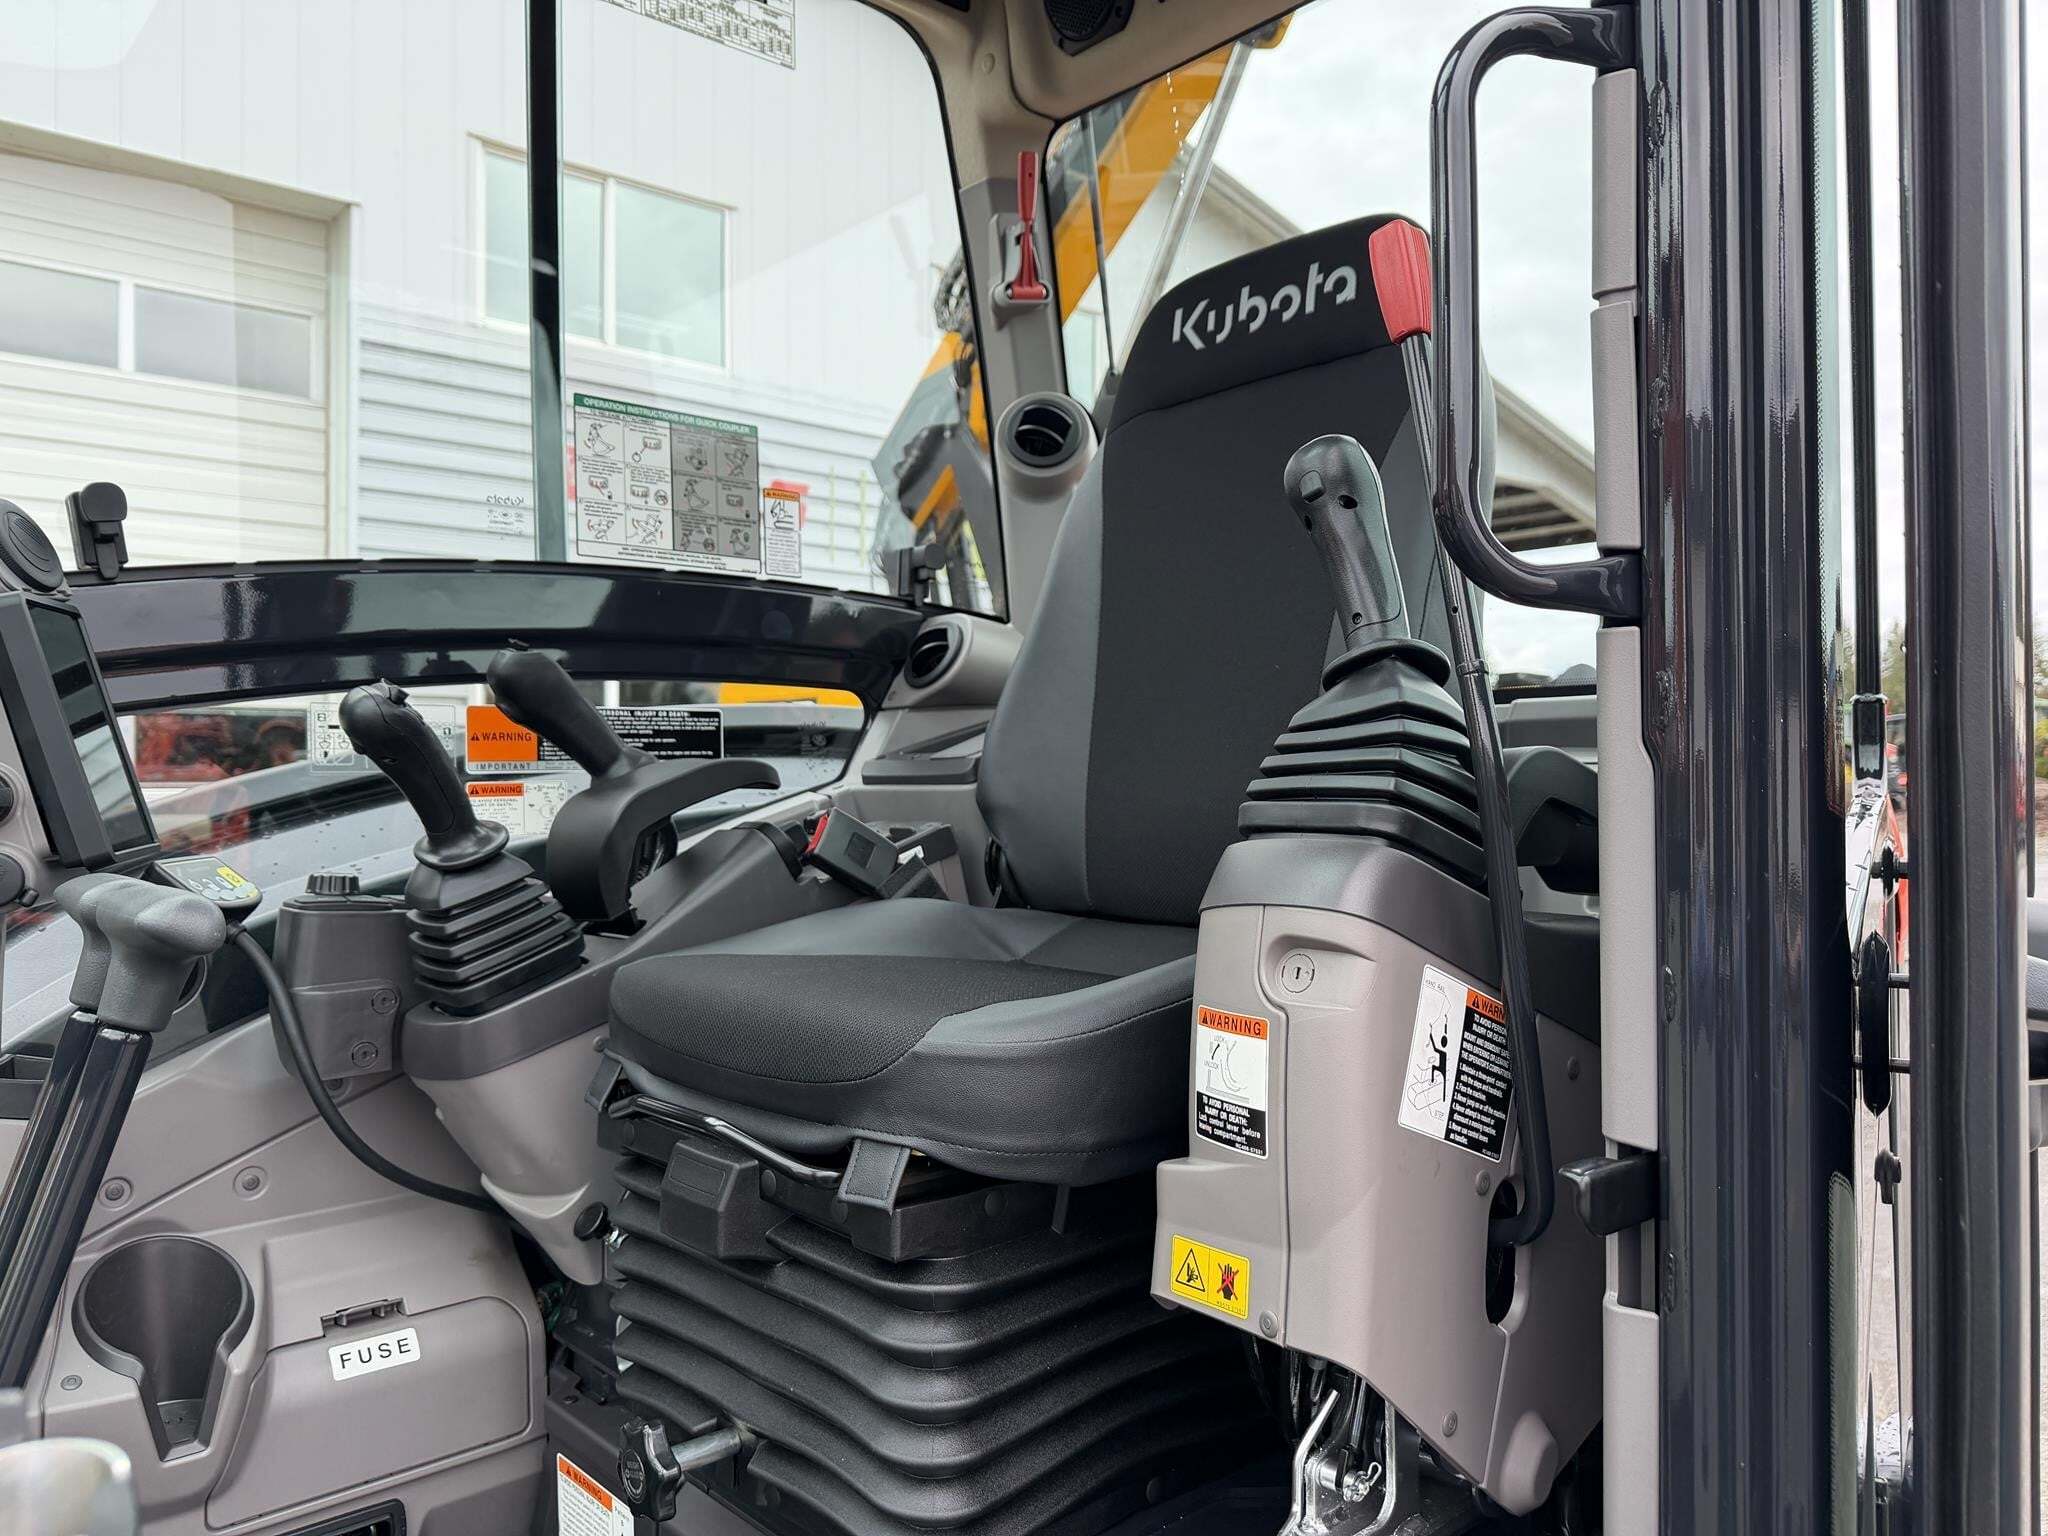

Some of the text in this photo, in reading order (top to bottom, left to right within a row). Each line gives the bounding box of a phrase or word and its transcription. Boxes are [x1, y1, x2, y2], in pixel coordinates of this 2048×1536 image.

[1172, 261, 1357, 350] Kubota
[583, 397, 751, 434] OPERATION INSTRUCTIONS FOR QUICK COUPLER
[482, 732, 532, 742] WARNING
[476, 762, 532, 770] IMPORTANT
[480, 784, 521, 794] WARNING
[1482, 1000, 1504, 1019] WARN
[1208, 1013, 1261, 1036] WARNING
[1202, 1095, 1250, 1118] TO AVOID PERSONAL
[1205, 1105, 1248, 1126] INJURY OR DEATH:
[1199, 1111, 1261, 1139] Lock control lever before
[1214, 1128, 1247, 1144] compartment.
[340, 1338, 411, 1369] FUSE
